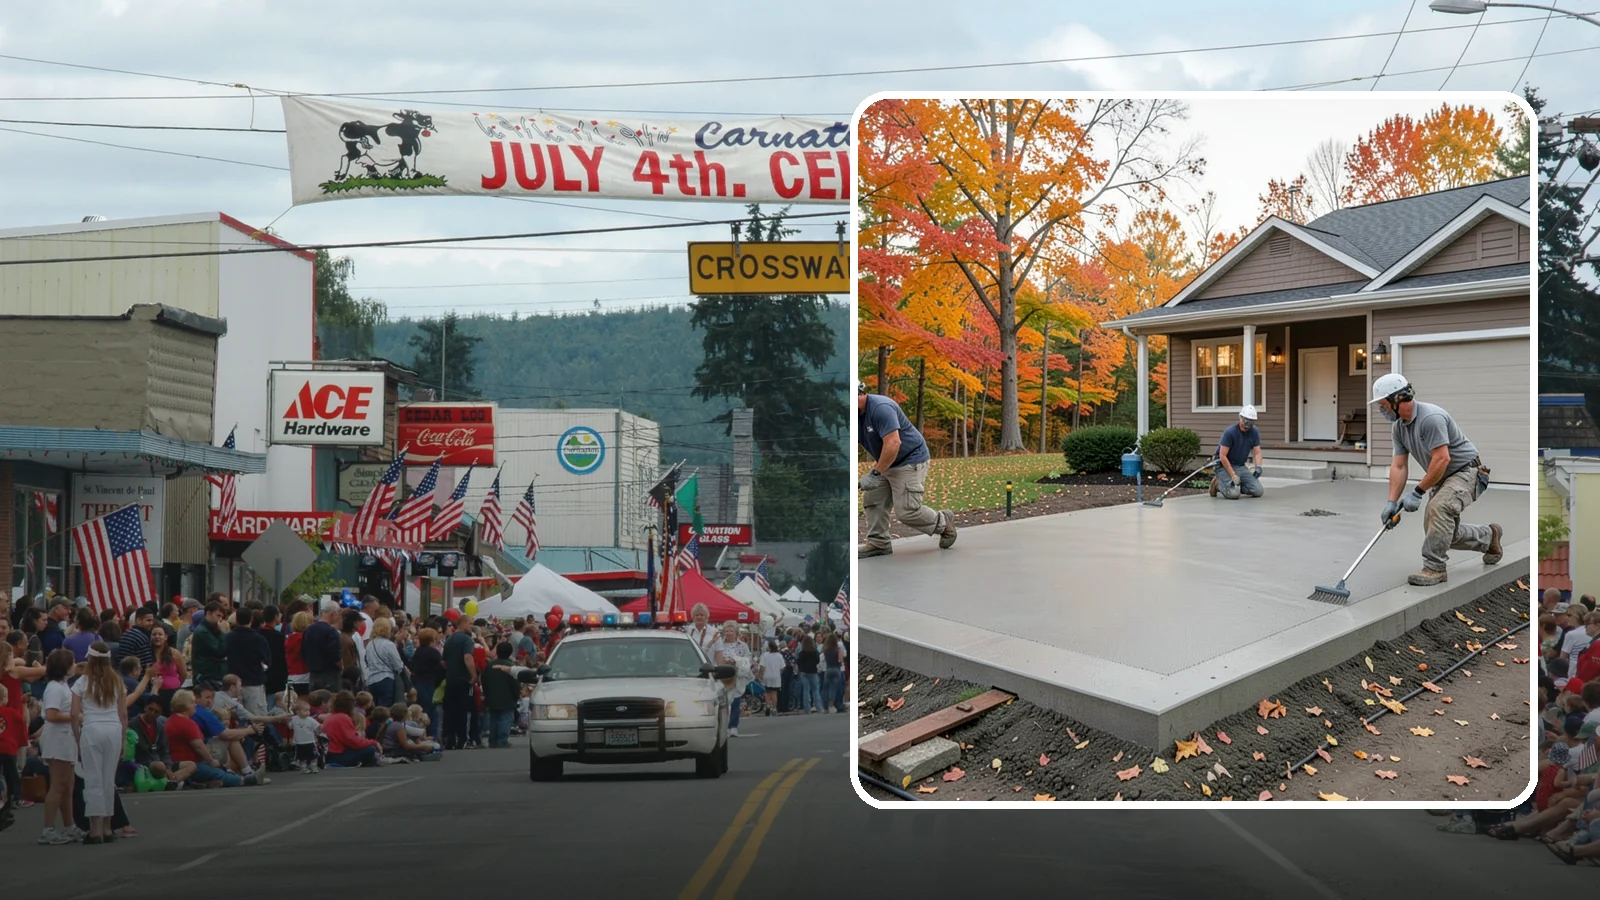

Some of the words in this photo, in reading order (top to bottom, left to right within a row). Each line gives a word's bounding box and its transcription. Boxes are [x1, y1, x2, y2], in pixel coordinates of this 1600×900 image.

[694, 121, 850, 150] Carnat
[480, 142, 605, 193] JULY
[632, 150, 746, 199] 4th.
[697, 253, 850, 280] CROSSWA
[282, 379, 374, 420] ACE
[405, 409, 452, 421] CEDAR
[461, 409, 485, 421] LOG
[283, 421, 371, 436] Hardware
[416, 427, 477, 447] Coca-Cola
[353, 467, 384, 480] Simpl
[95, 485, 124, 495] Vincent
[126, 486, 135, 495] de
[137, 486, 155, 495] Paul
[213, 516, 331, 535] HARDARE
[688, 526, 741, 535] CRNATION
[699, 535, 730, 543] GLASS
